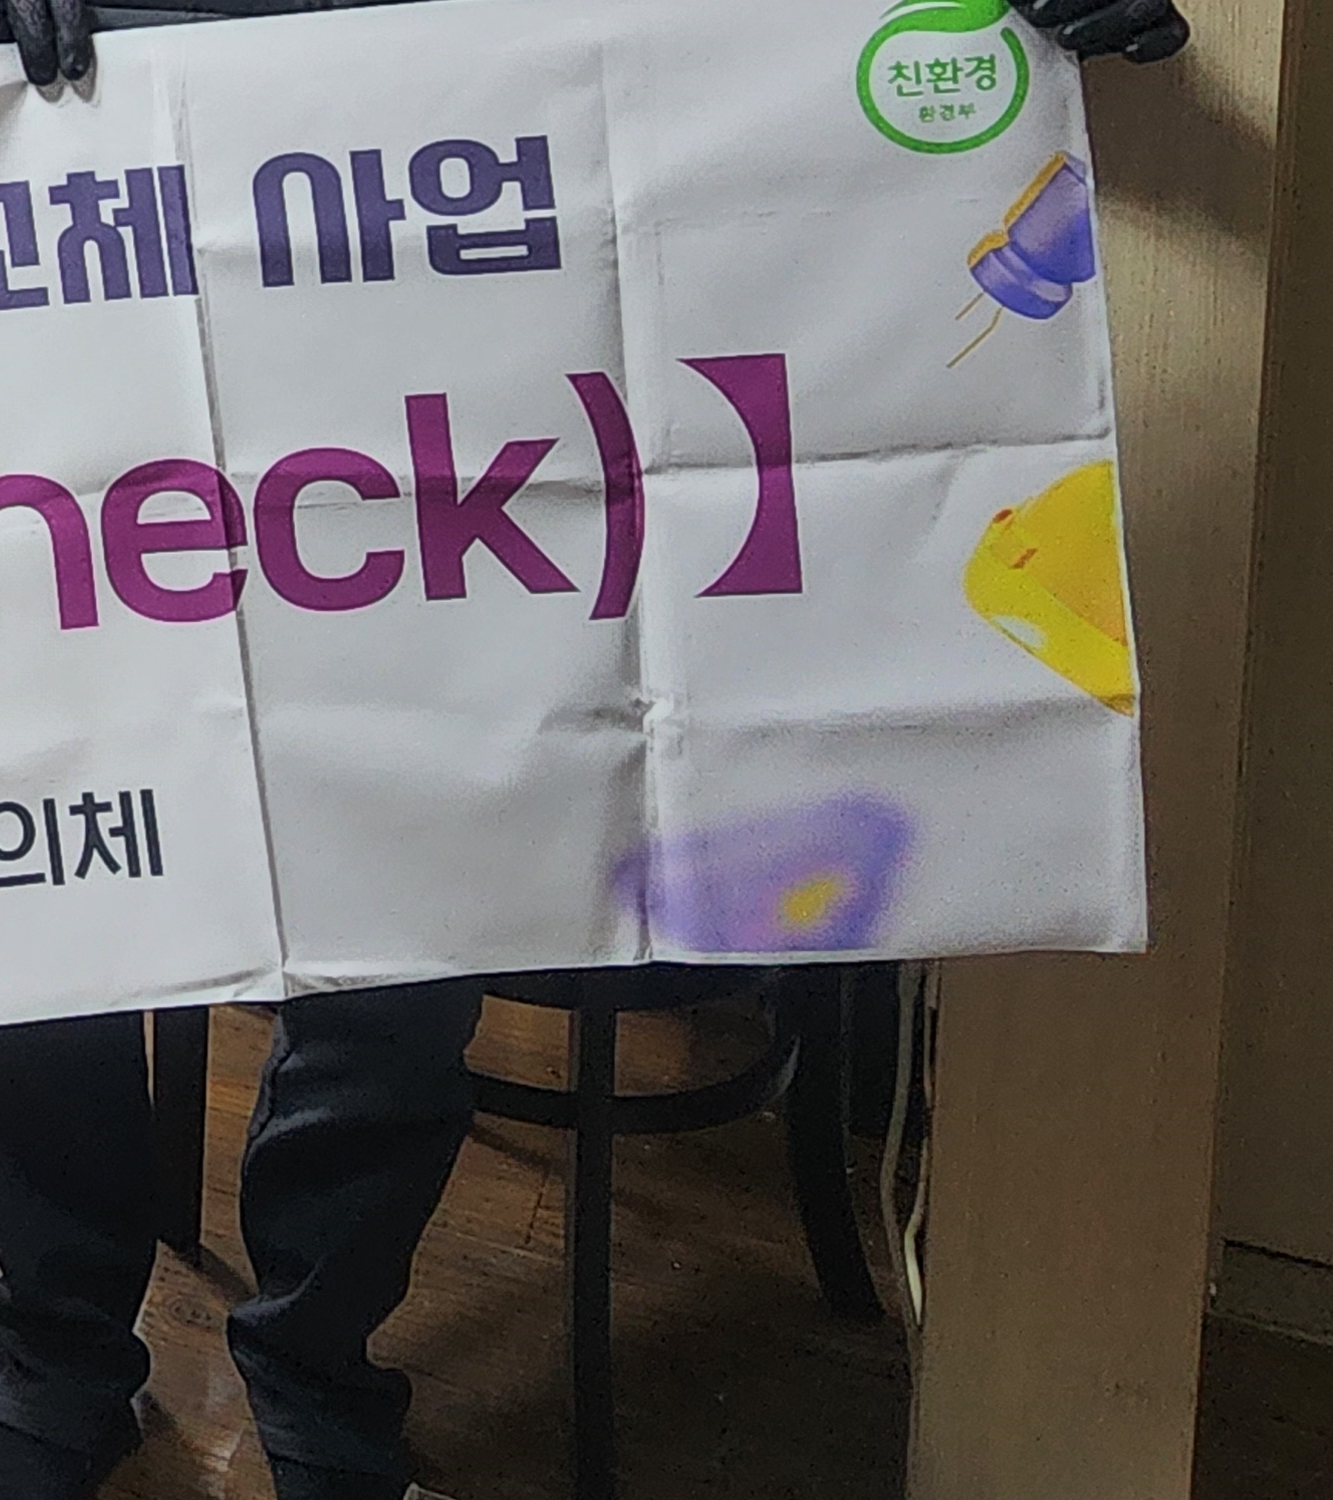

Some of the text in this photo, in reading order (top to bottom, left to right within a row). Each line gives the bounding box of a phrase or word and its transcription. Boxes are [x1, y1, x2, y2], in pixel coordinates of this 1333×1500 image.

[887, 53, 997, 97] 친환경
[918, 102, 976, 123] 환경부
[251, 134, 563, 289] 사업
